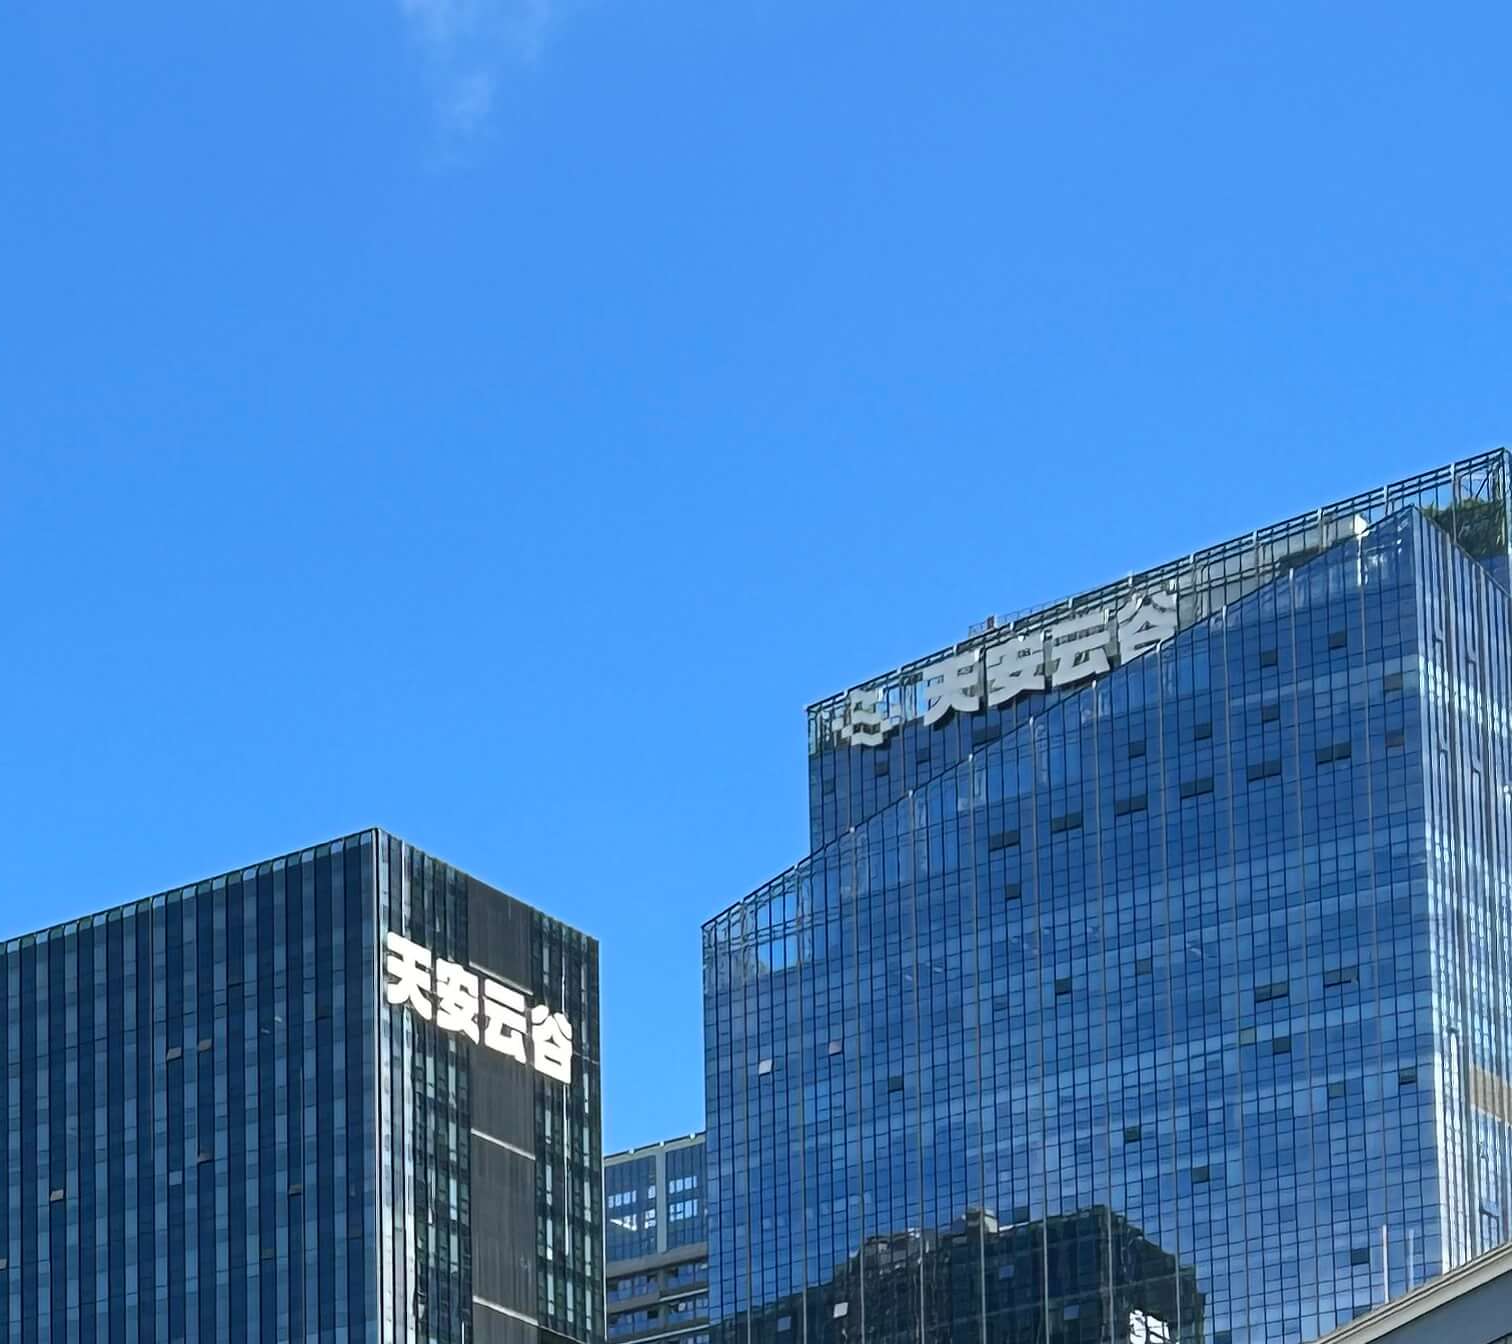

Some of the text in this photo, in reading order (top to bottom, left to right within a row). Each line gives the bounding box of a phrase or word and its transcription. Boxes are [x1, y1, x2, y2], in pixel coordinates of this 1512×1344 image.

[924, 589, 1178, 727] 天安云谷
[386, 930, 573, 1085] 天安云谷
